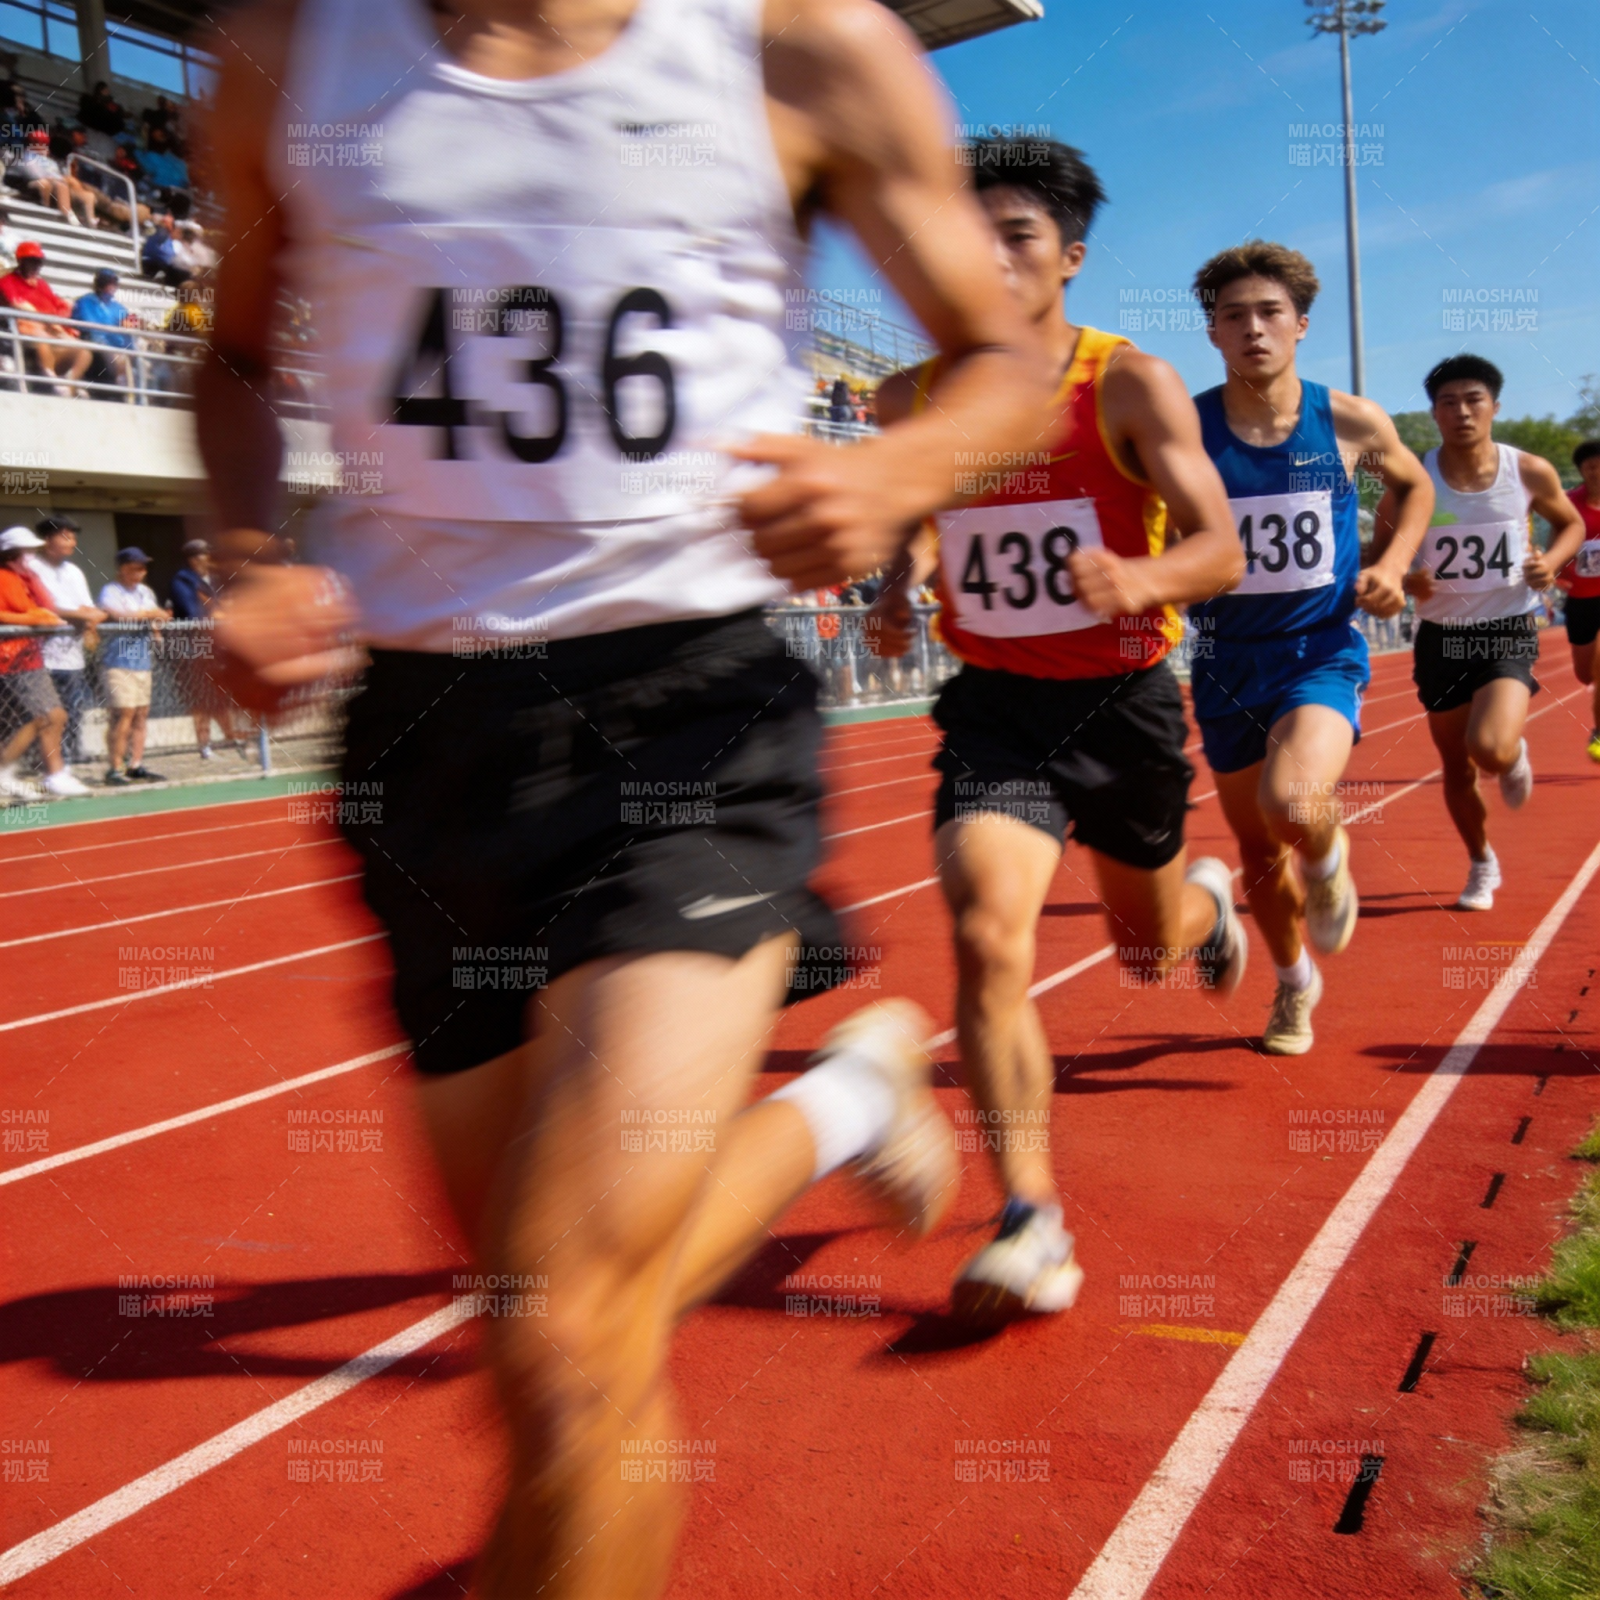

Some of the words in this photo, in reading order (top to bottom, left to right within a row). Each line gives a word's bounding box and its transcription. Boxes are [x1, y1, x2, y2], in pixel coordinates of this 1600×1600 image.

[383, 286, 676, 464] 436
[960, 525, 1080, 612] 438
[1435, 531, 1515, 580] 234
